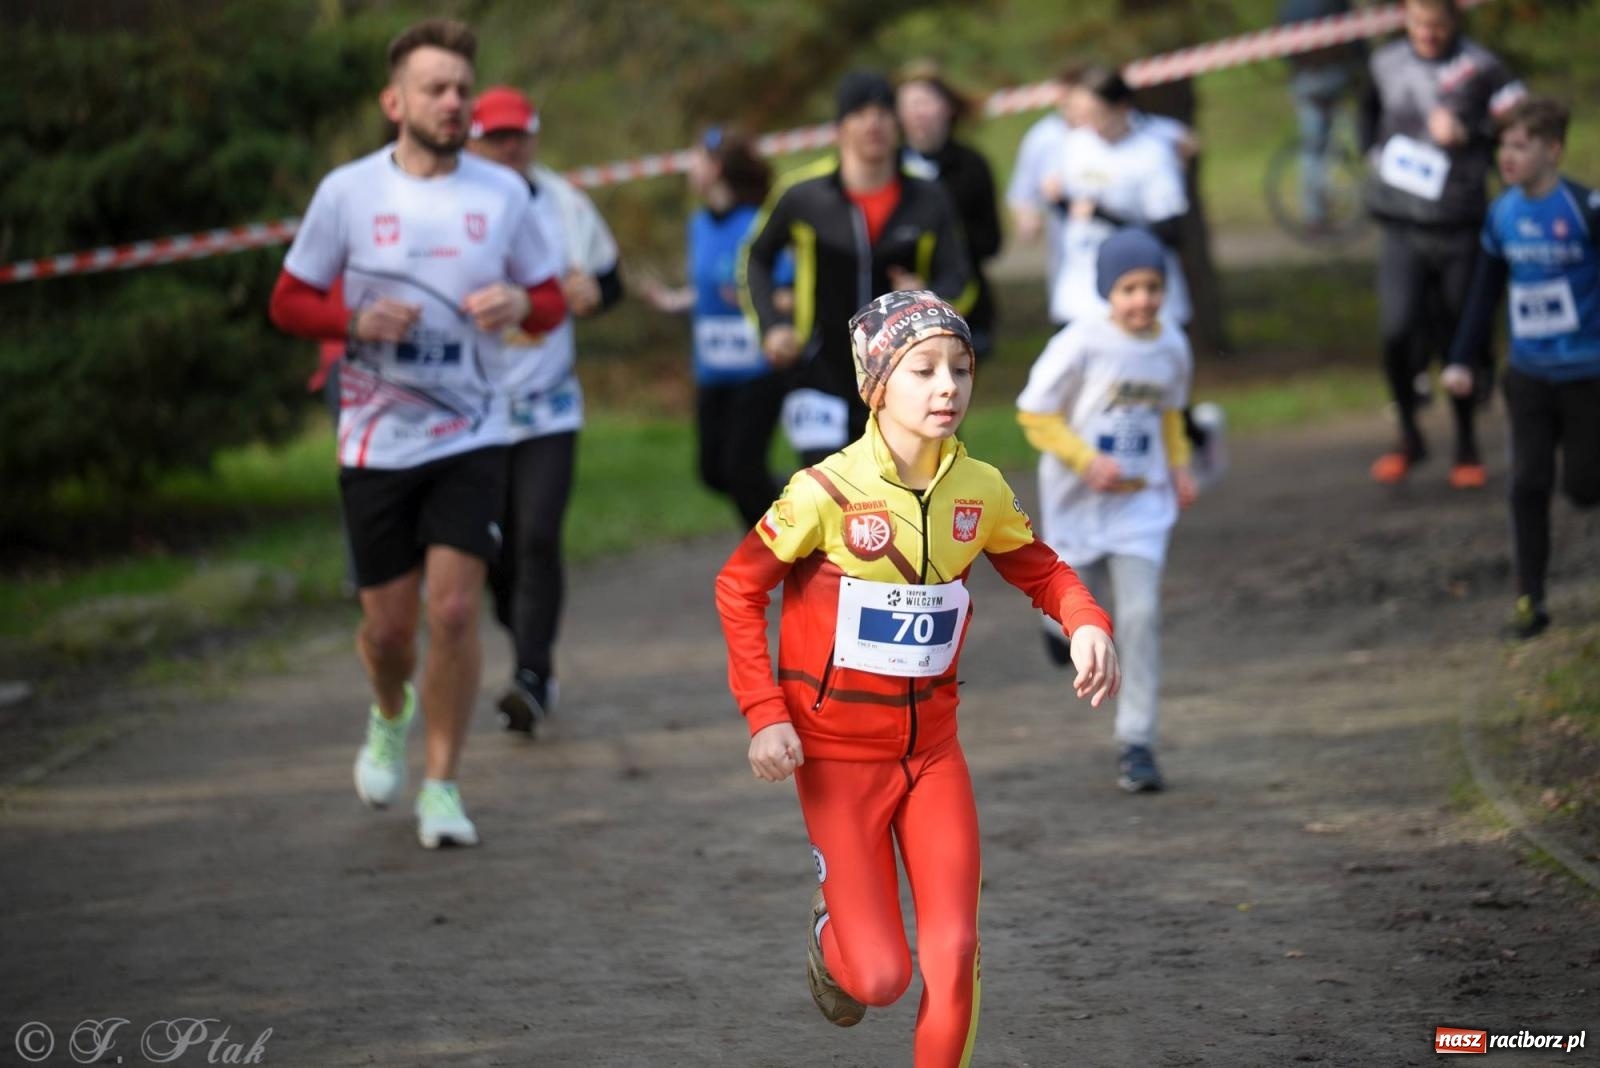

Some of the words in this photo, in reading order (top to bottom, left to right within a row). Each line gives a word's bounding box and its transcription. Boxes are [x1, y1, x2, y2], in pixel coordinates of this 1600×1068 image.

[954, 498, 984, 506] POLSKA
[906, 596, 943, 606] WILCZYM
[892, 612, 934, 643] 70
